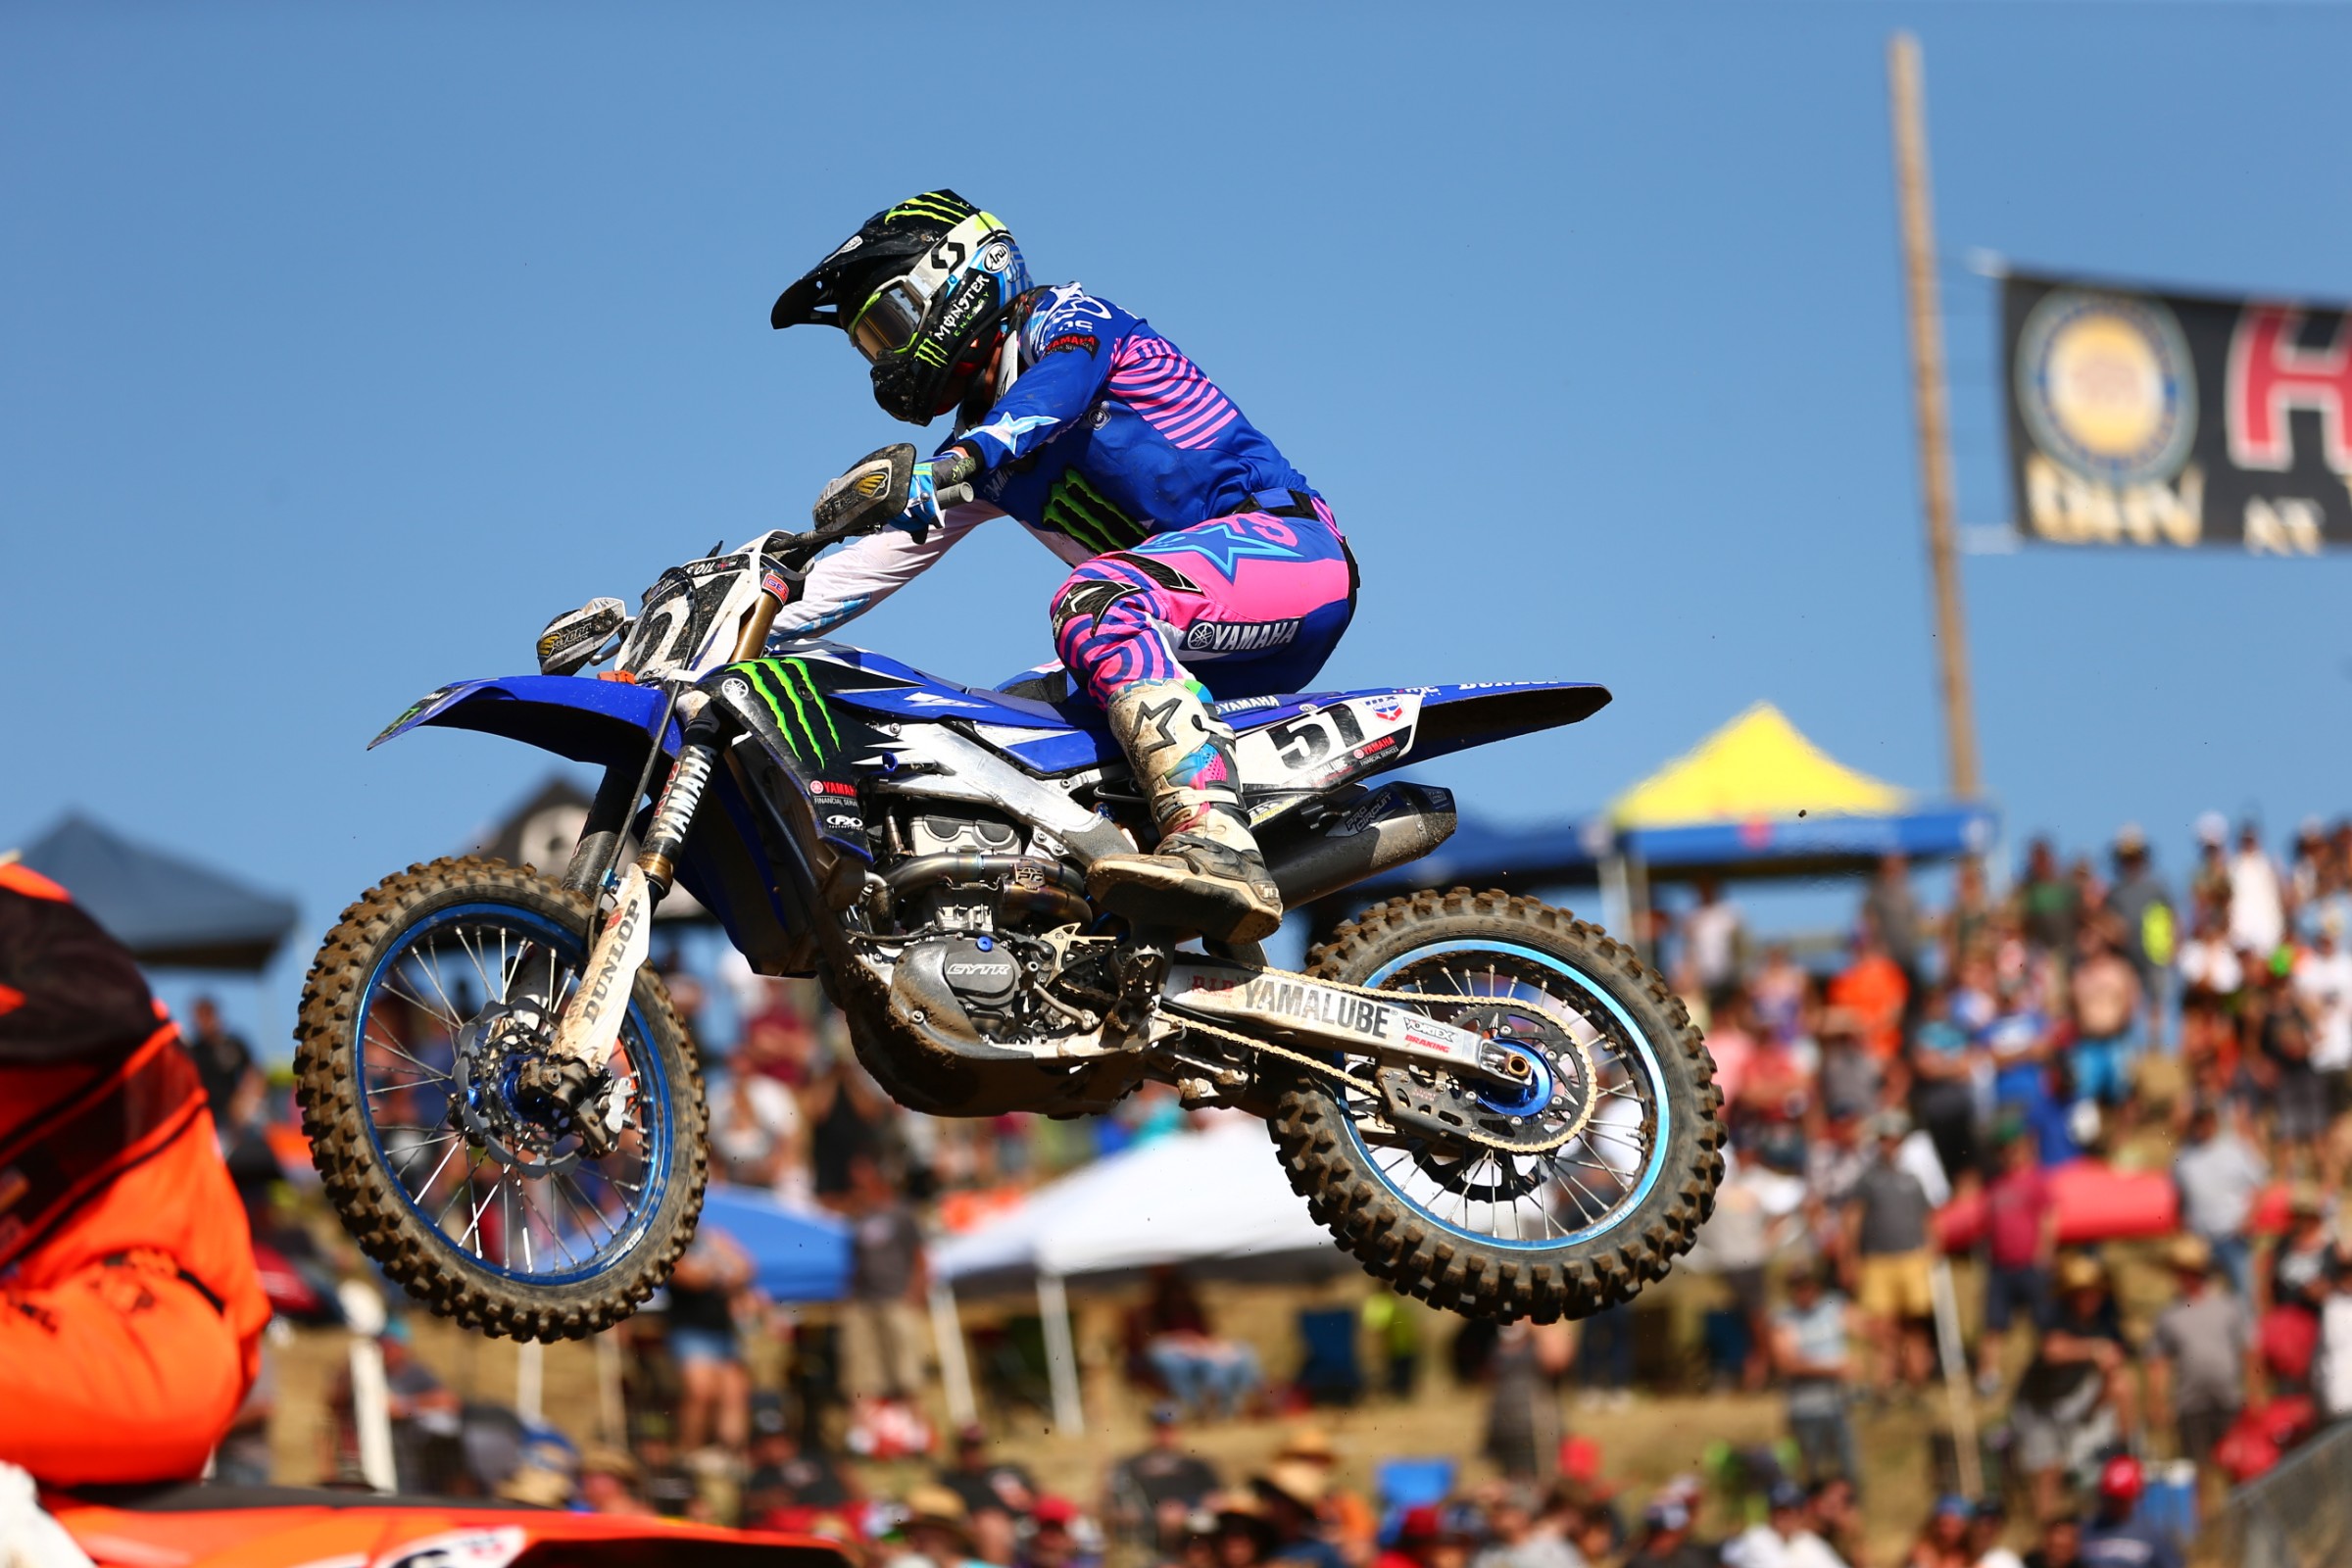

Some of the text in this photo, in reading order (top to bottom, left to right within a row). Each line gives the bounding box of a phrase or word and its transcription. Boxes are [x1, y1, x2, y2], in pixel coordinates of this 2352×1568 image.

[934, 274, 990, 341] MONSTER
[694, 562, 715, 575] OIL
[1212, 620, 1300, 651] YAMAHA
[1224, 695, 1281, 713] YAMAHA
[1265, 703, 1365, 770] 51
[1363, 736, 1396, 756] YAMAHA
[1380, 745, 1399, 760] SERVICES
[654, 745, 718, 844] YAMAHA
[813, 797, 843, 807] FINANCIAL
[1345, 806, 1368, 830] PRO
[1355, 792, 1393, 832] CIRCUIT
[582, 898, 641, 1026] DUNLOP
[947, 963, 1011, 975] GYTR
[1244, 976, 1392, 1040] YAMALUBE
[1403, 1016, 1458, 1043] VORTEX
[1404, 1034, 1451, 1054] BRAKING
